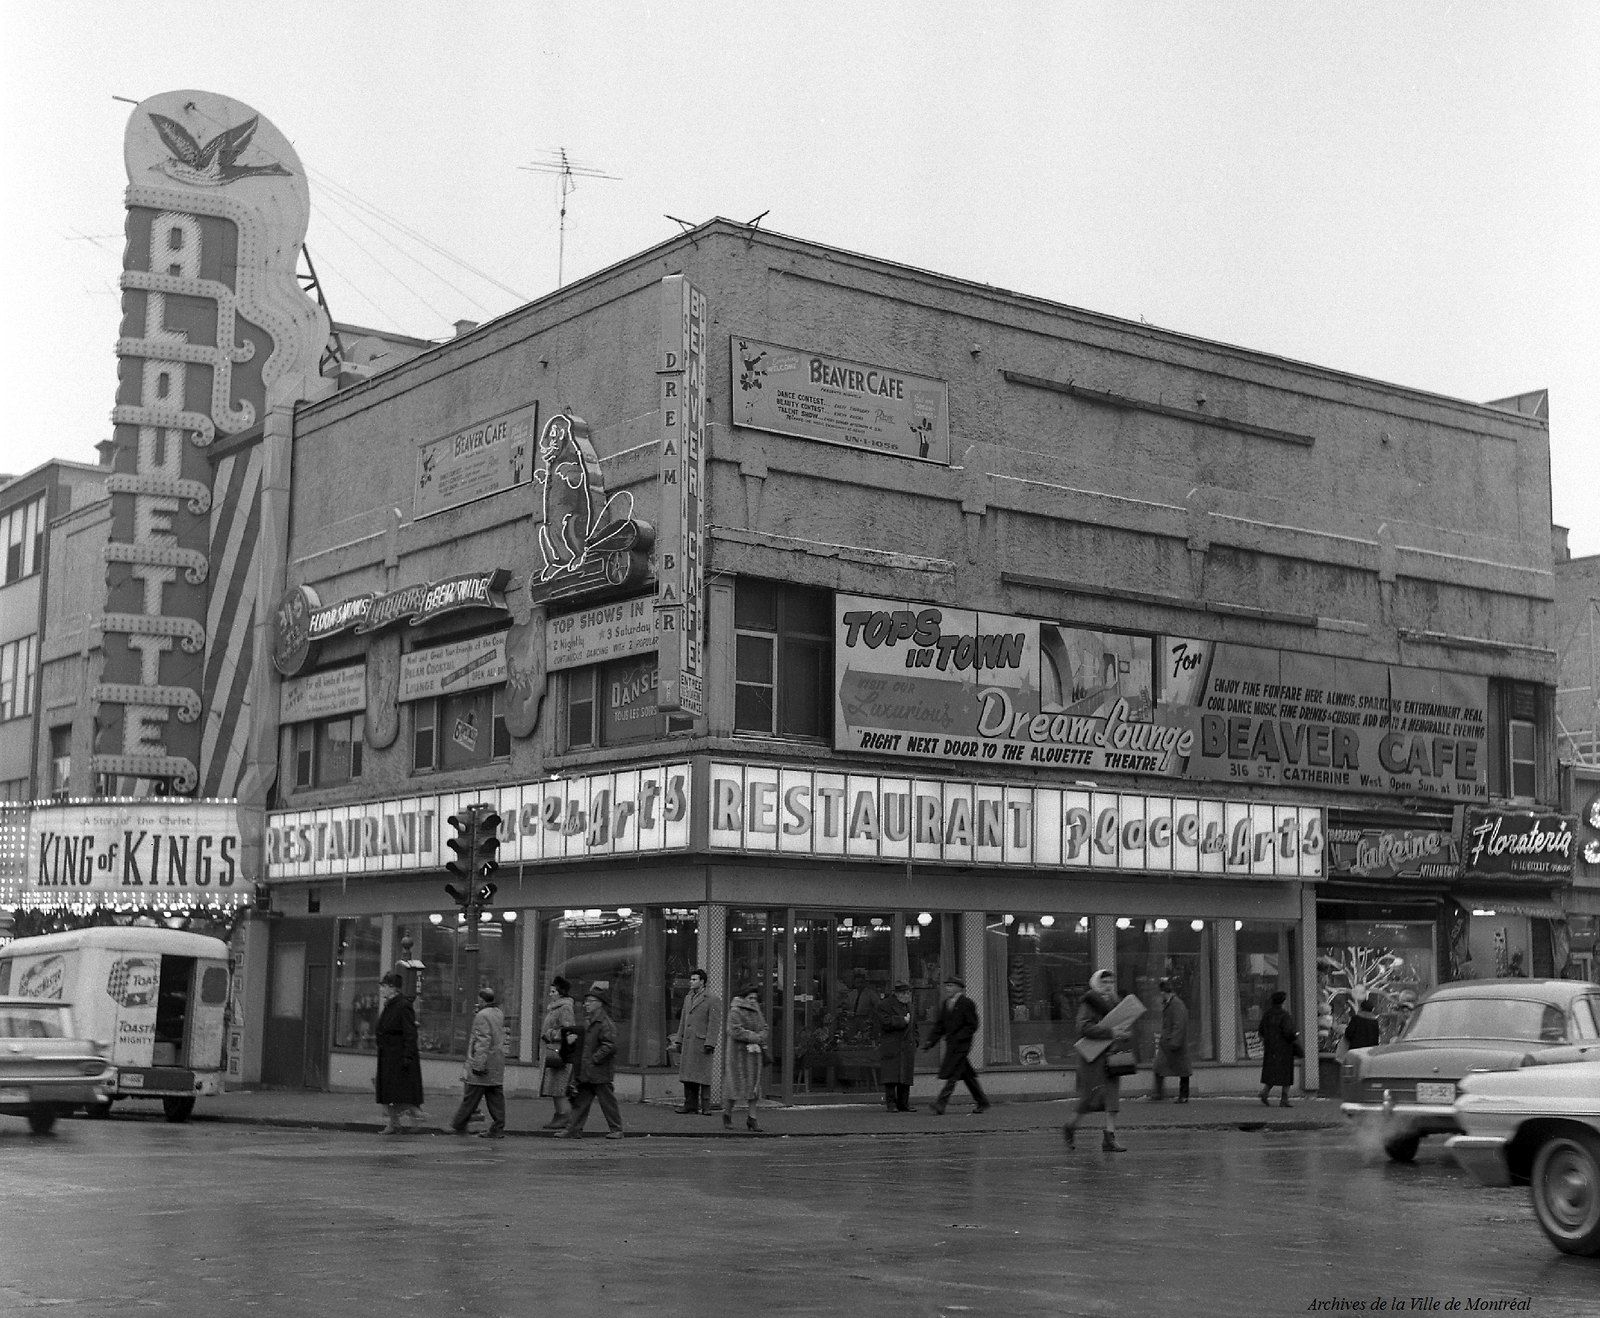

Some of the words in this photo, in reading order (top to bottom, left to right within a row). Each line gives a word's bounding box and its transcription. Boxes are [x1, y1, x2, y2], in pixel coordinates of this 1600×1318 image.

[689, 287, 699, 497] BEAVER
[777, 390, 796, 400] DANCE
[809, 358, 864, 392] BEAVER
[866, 371, 904, 400] CAFE
[664, 353, 678, 485] DREAM
[776, 398, 800, 408] BEAUTY
[778, 406, 799, 416] TALENT
[455, 433, 484, 458] BEAVER
[484, 421, 508, 446] CAFE
[121, 210, 202, 757] ALOUETTE
[663, 554, 676, 631] BAR
[688, 531, 697, 670] CAFE
[553, 617, 574, 634] TOP
[580, 606, 623, 629] SHOWS
[631, 602, 644, 617] IN
[553, 640, 558, 650] 2
[560, 635, 585, 652] Nightly
[607, 628, 613, 640] 3
[616, 622, 651, 638] Saturday
[843, 608, 942, 649] TOPS
[905, 649, 934, 668] IN
[936, 633, 1026, 672] TOWN
[1172, 643, 1202, 678] For
[630, 708, 640, 719] LES
[1207, 696, 1225, 711] COOL
[1227, 697, 1252, 714] DANCE
[1280, 704, 1298, 719] FINE
[1299, 706, 1327, 722] DRINKS
[1332, 710, 1360, 726] CUISINE
[1363, 713, 1378, 727] ADD
[1379, 714, 1390, 728] UP
[1391, 716, 1399, 729] TO
[1401, 718, 1406, 731] A
[1408, 718, 1451, 736] MEMORABLE
[1453, 723, 1485, 739] EVENING
[1214, 678, 1240, 694] ENJOY
[1242, 681, 1261, 697] FINE
[1263, 684, 1302, 701] FUNFARE
[1304, 688, 1323, 703] HERE
[1464, 708, 1483, 722] REAL
[977, 687, 1099, 745] Dream
[1093, 696, 1194, 771] Lounge
[1201, 714, 1360, 771] BEAVER
[1378, 732, 1478, 782] CAFE
[907, 735, 939, 753] NEXT
[944, 738, 979, 757] DOOR
[982, 742, 998, 759] TO
[1002, 744, 1024, 761] THE
[1031, 748, 1094, 766] ALOUETTE
[1105, 752, 1158, 771] THEATRE
[1230, 763, 1249, 777] 316
[1258, 766, 1276, 780] ST.
[1283, 768, 1349, 785] CATHERINE
[1360, 775, 1382, 788] West
[1390, 776, 1412, 792] Open
[1441, 782, 1450, 794] at
[137, 816, 155, 826] the
[158, 816, 191, 826] Christ
[266, 810, 435, 864] RESTAURANT
[561, 800, 587, 836] des
[586, 775, 687, 847] Arts
[713, 778, 1033, 849] RESTAURANT
[1066, 807, 1199, 859] Place
[1201, 821, 1228, 854] des
[1228, 816, 1324, 866] Arts
[38, 832, 95, 886] KING
[98, 842, 119, 872] of
[122, 830, 236, 887] KINGS
[1472, 817, 1572, 866] Florateria
